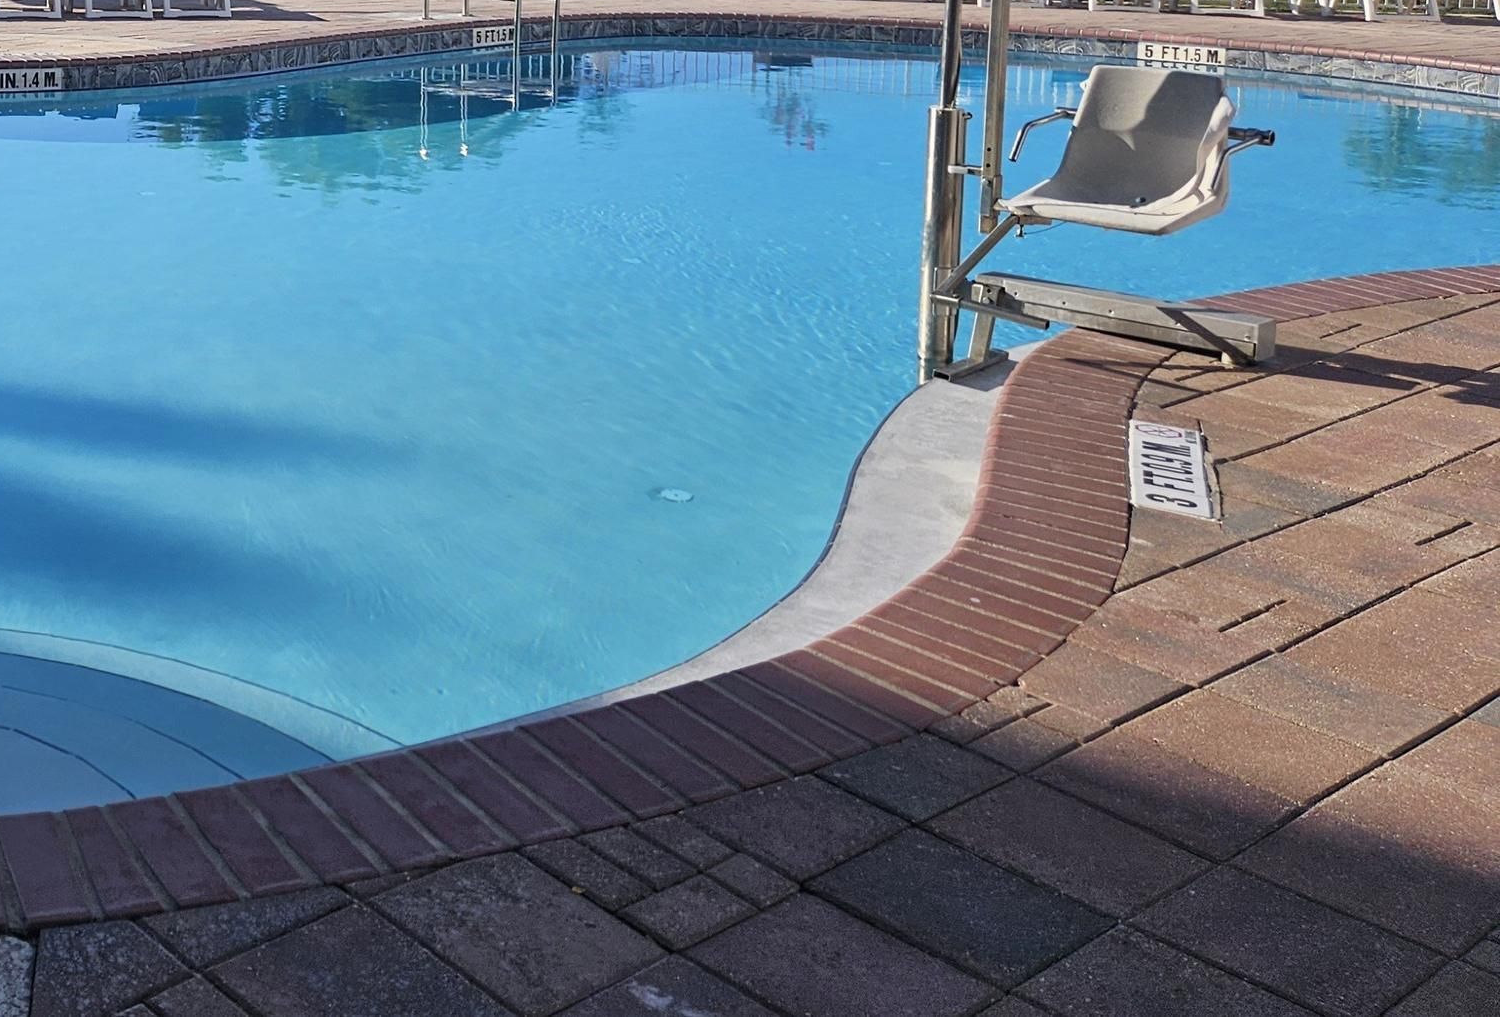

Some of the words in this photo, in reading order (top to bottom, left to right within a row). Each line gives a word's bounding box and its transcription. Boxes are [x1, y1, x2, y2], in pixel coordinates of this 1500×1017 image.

[476, 30, 482, 43] 5
[1145, 45, 1154, 58] 5
[1206, 49, 1222, 64] M.
[44, 72, 58, 87] M.
[1145, 493, 1198, 508] 3
